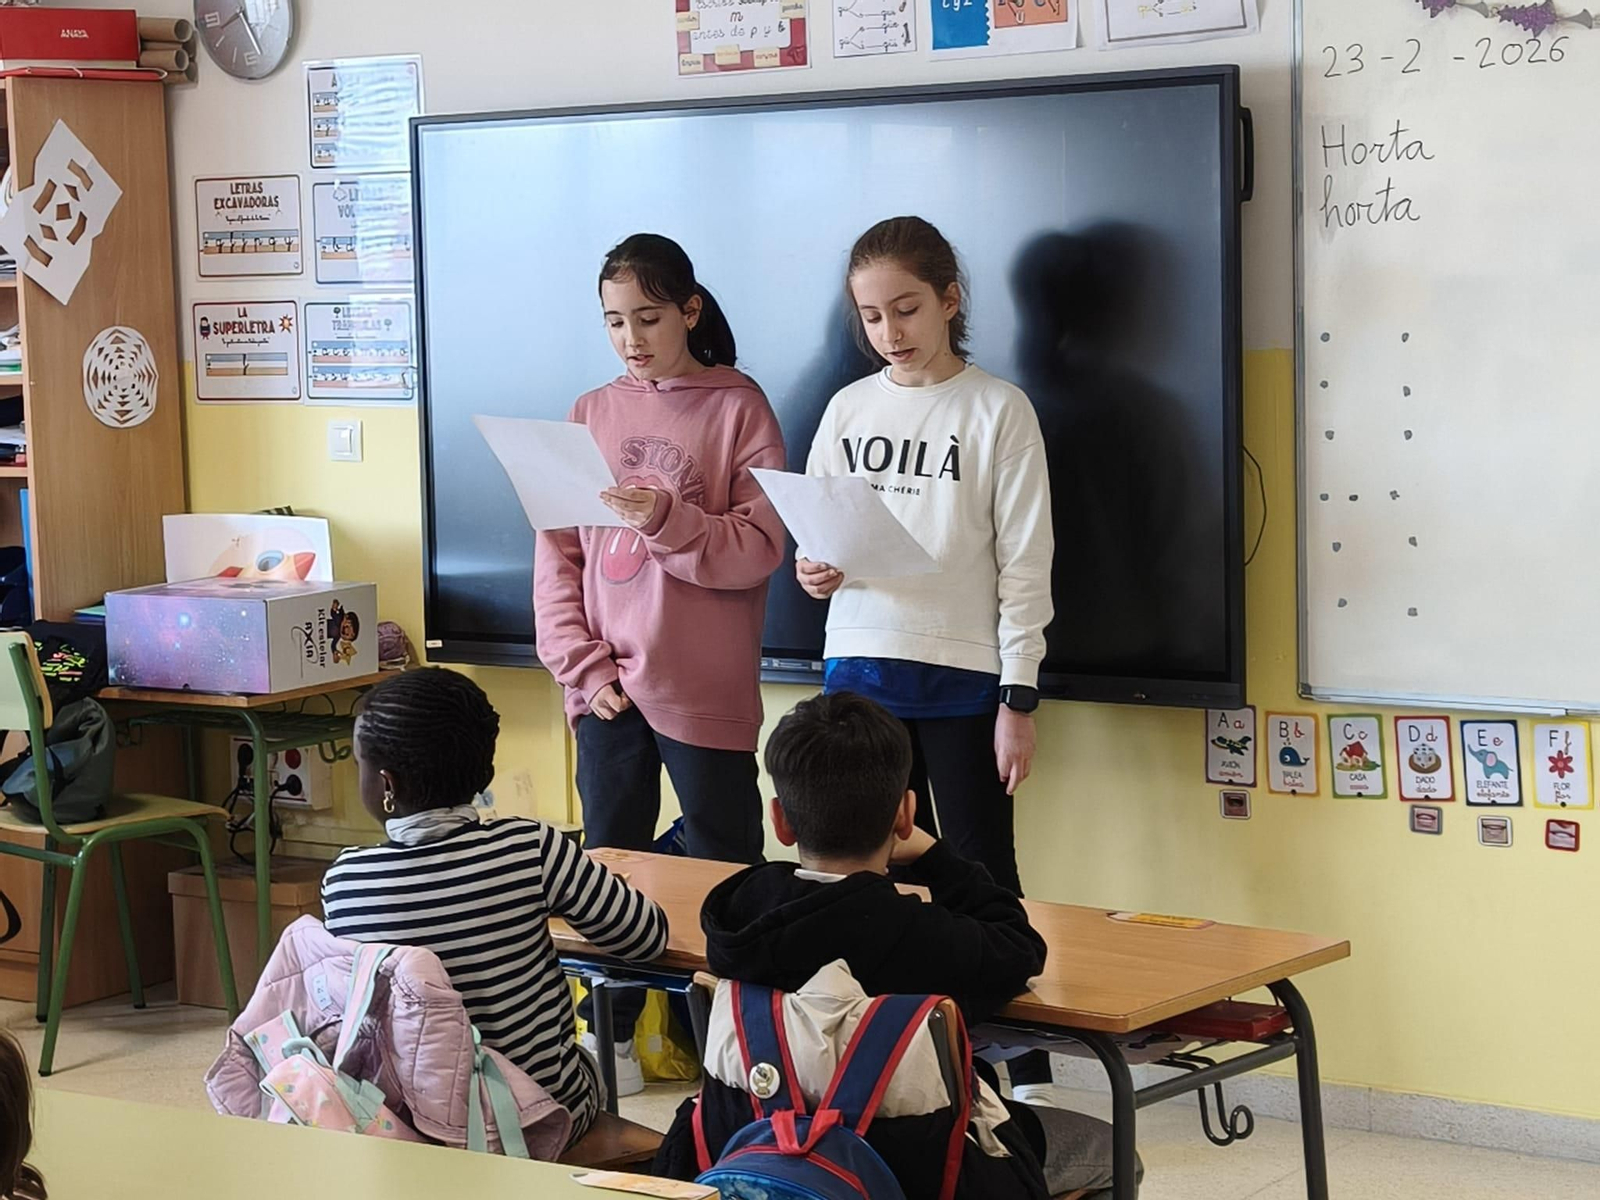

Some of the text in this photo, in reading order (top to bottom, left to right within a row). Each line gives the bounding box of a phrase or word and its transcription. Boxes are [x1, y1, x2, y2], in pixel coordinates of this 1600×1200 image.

[205, 12, 220, 28] 9
[1321, 119, 1435, 168] Horta
[230, 182, 263, 195] LETRAS
[213, 196, 279, 210] EXCAVADORAS
[1319, 174, 1421, 228] horta
[237, 307, 248, 318] LA
[213, 320, 275, 335] SUPERLETRA
[842, 434, 961, 482] VOILÀ
[1217, 711, 1245, 730] A a
[1279, 720, 1305, 739] B b
[1343, 723, 1368, 740] C c
[1408, 725, 1438, 742] D d
[1477, 729, 1504, 747] E e
[1548, 729, 1559, 748] F
[1349, 773, 1367, 782] CASA
[1415, 776, 1436, 784] DADO
[1476, 780, 1509, 789] ELEFANTE
[1553, 782, 1571, 791] FLOR
